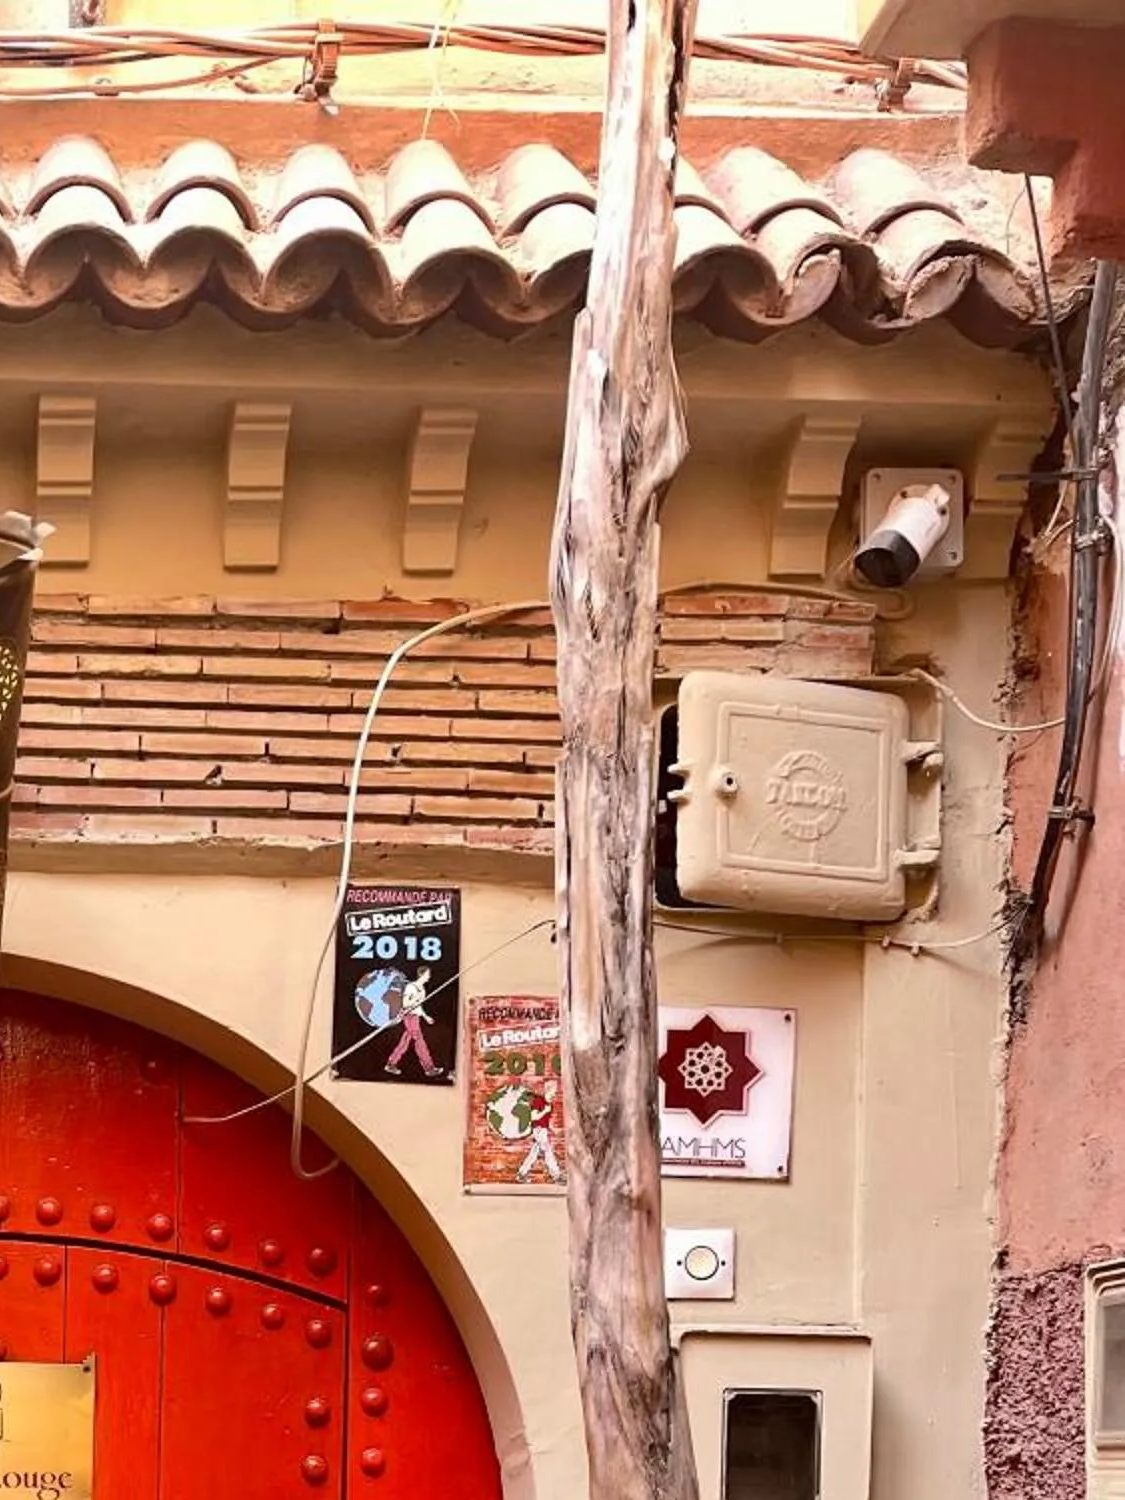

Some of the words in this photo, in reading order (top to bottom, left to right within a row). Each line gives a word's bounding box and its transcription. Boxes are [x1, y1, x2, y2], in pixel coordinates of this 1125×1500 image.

[430, 891, 452, 903] PAR
[350, 916, 371, 931] Le
[372, 905, 447, 928] Routard
[350, 935, 442, 961] 2018
[482, 1033, 501, 1048] Le
[502, 1026, 561, 1045] Routar
[661, 1136, 746, 1159] AMHMS
